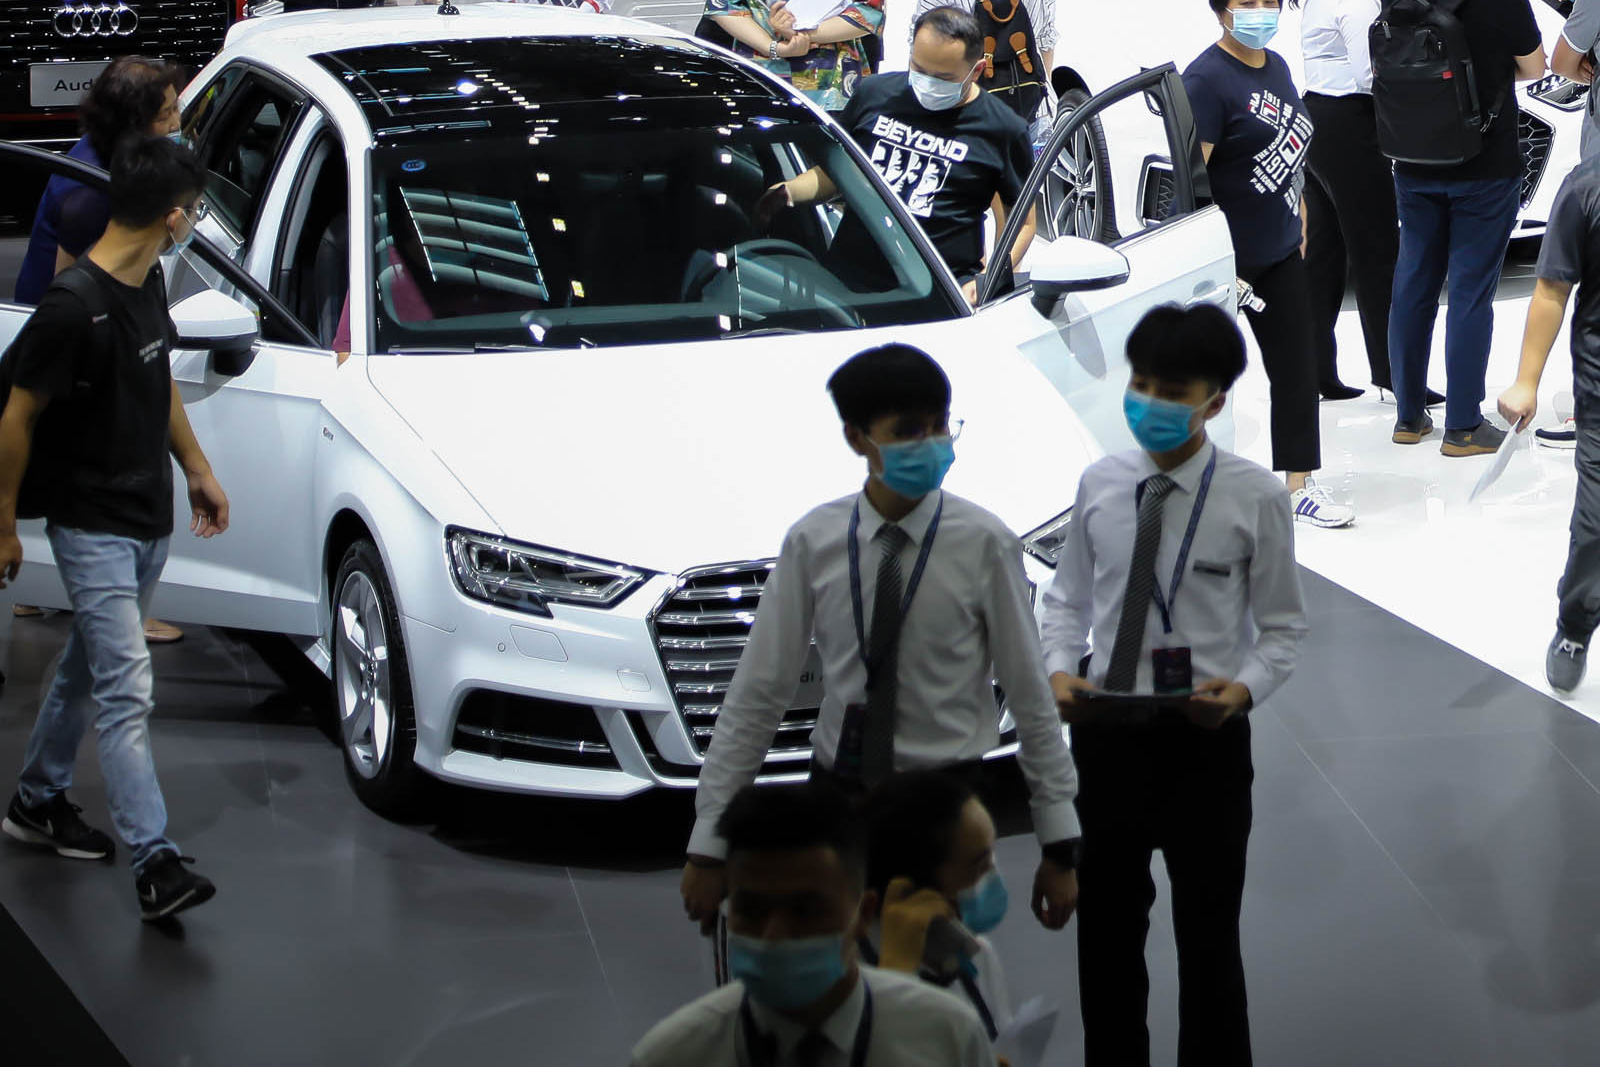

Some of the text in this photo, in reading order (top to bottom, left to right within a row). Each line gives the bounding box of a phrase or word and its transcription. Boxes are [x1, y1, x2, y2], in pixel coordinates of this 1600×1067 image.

[54, 79, 94, 92] Aud
[1247, 92, 1260, 114] FILA
[1263, 90, 1281, 108] 1911
[872, 115, 969, 163] BEYOND
[1261, 150, 1290, 185] 1911
